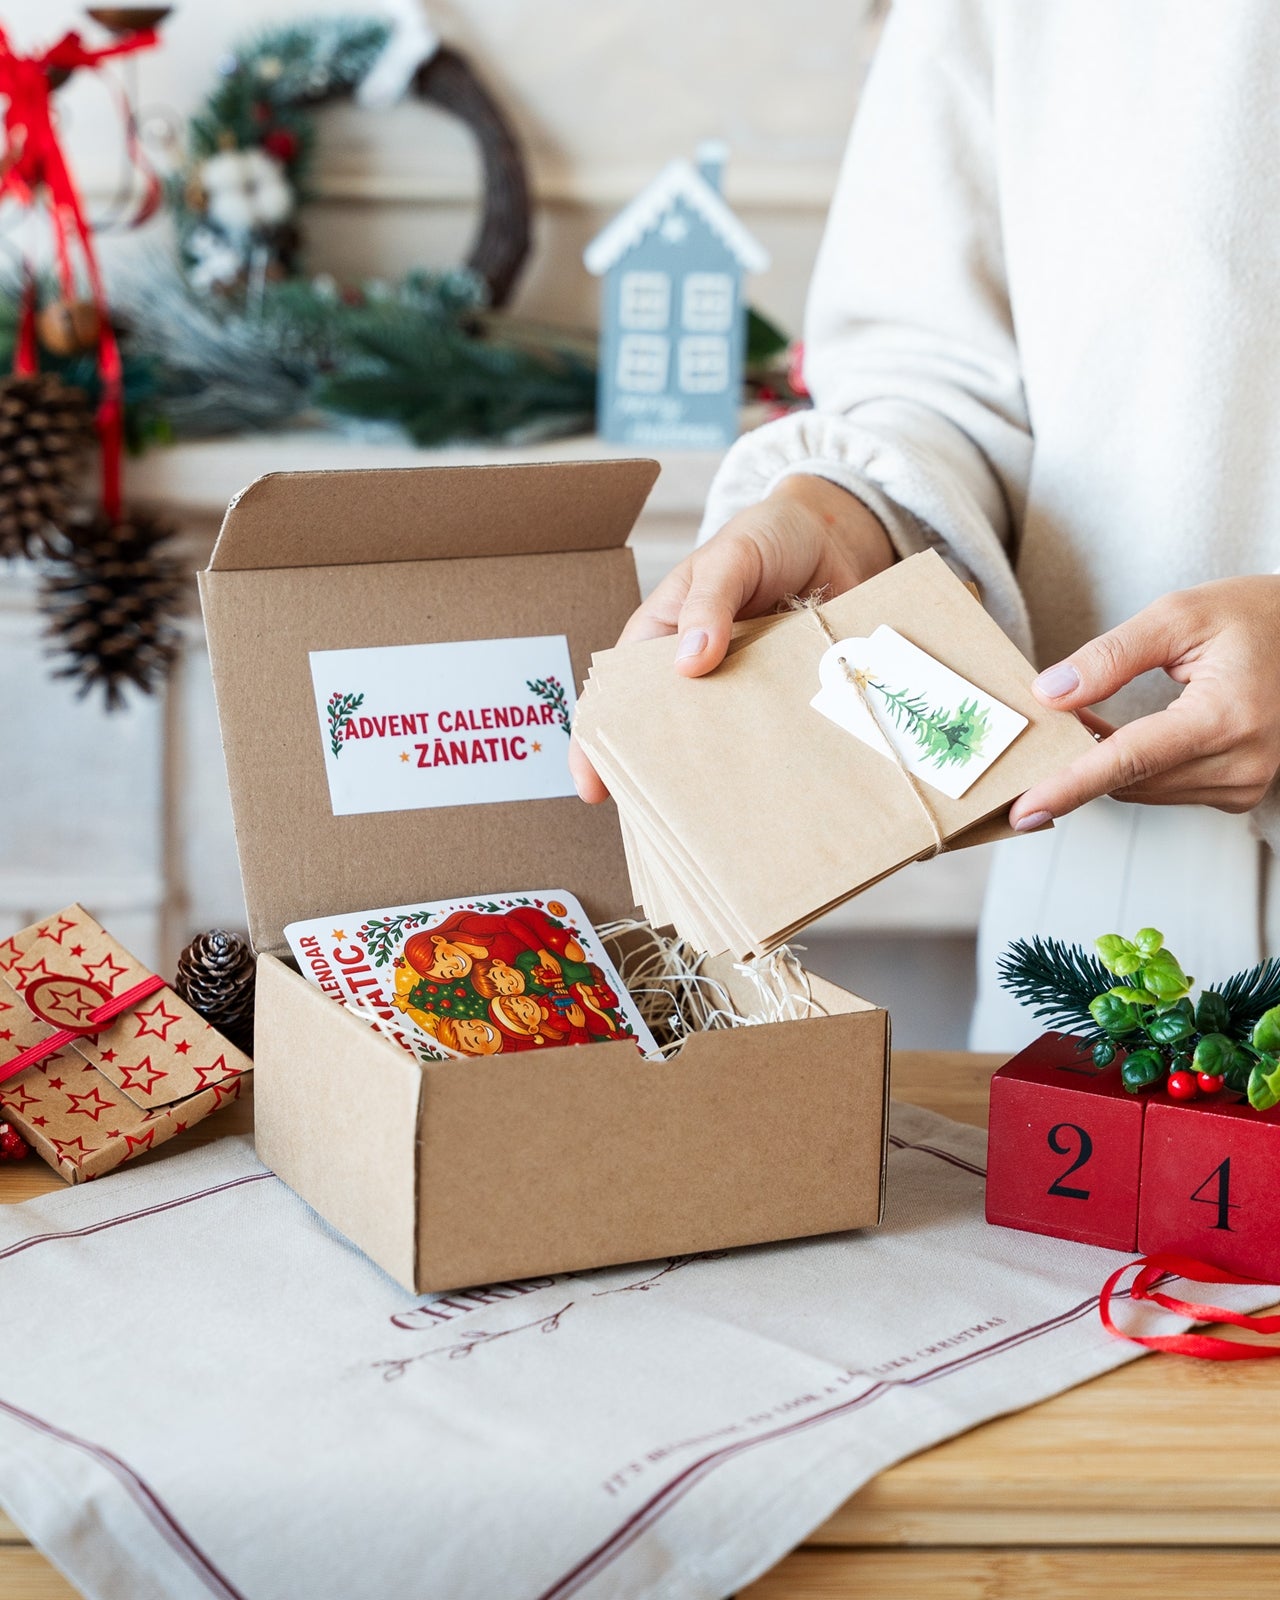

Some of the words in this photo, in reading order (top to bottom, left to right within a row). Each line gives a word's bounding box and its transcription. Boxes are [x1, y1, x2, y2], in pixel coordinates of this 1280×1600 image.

[345, 713, 429, 740] ADVENT
[437, 704, 555, 733] CALENDAR
[414, 736, 528, 768] ZĀNATIC
[1047, 1123, 1093, 1200] 2
[1190, 1156, 1241, 1232] 4
[916, 1314, 1008, 1359] CHRISTMAS
